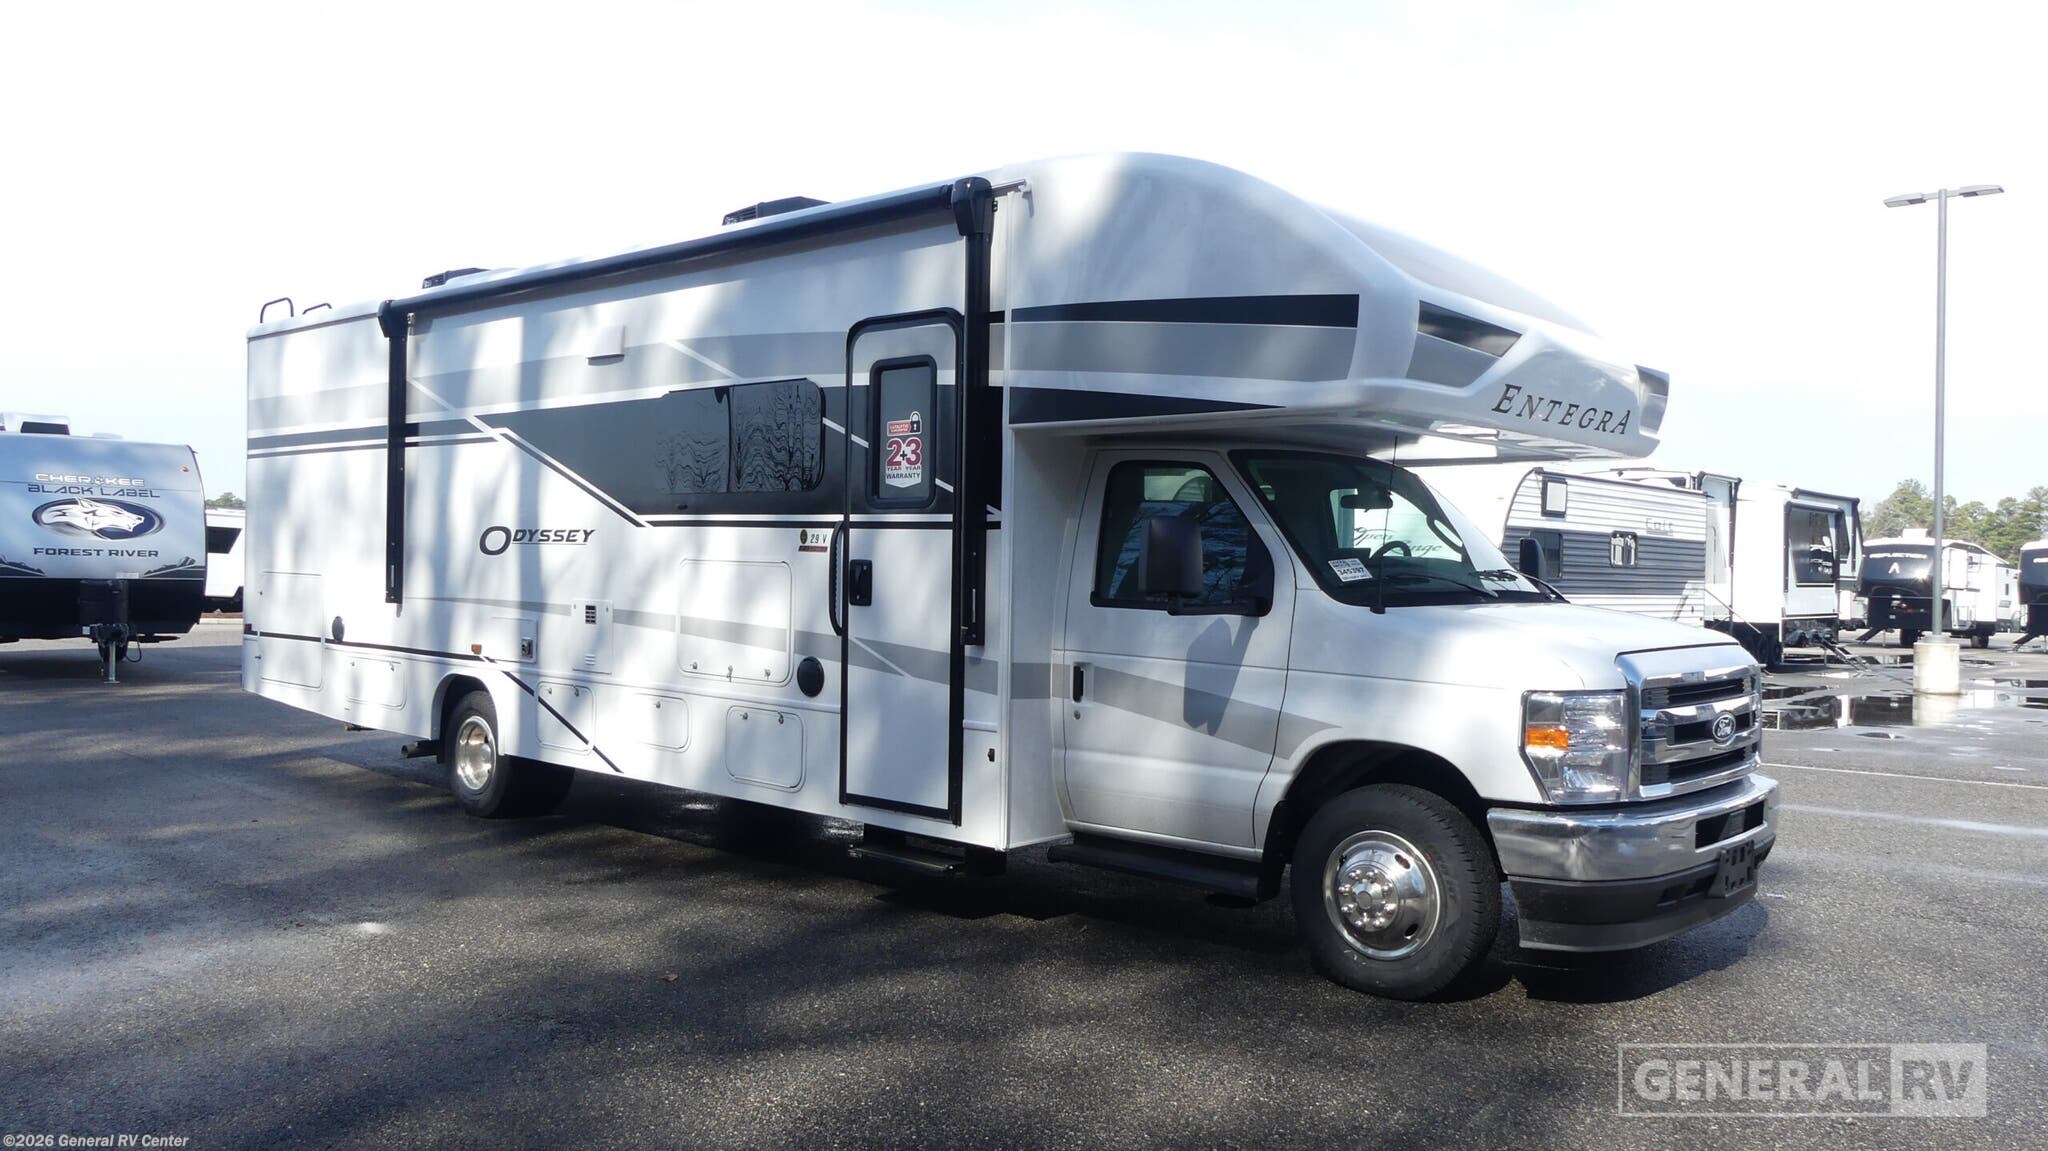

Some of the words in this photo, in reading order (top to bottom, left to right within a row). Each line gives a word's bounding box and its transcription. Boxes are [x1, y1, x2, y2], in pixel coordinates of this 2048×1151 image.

[1491, 383, 1631, 434] ENTEGRA
[886, 472, 920, 480] WARRANTY
[27, 483, 93, 495] BLACK
[100, 487, 161, 498] LABEL
[479, 525, 596, 556] ODYSSEY
[810, 533, 820, 543] 29
[822, 533, 828, 543] V
[33, 547, 104, 557] FOREST
[108, 549, 159, 557] RIVER
